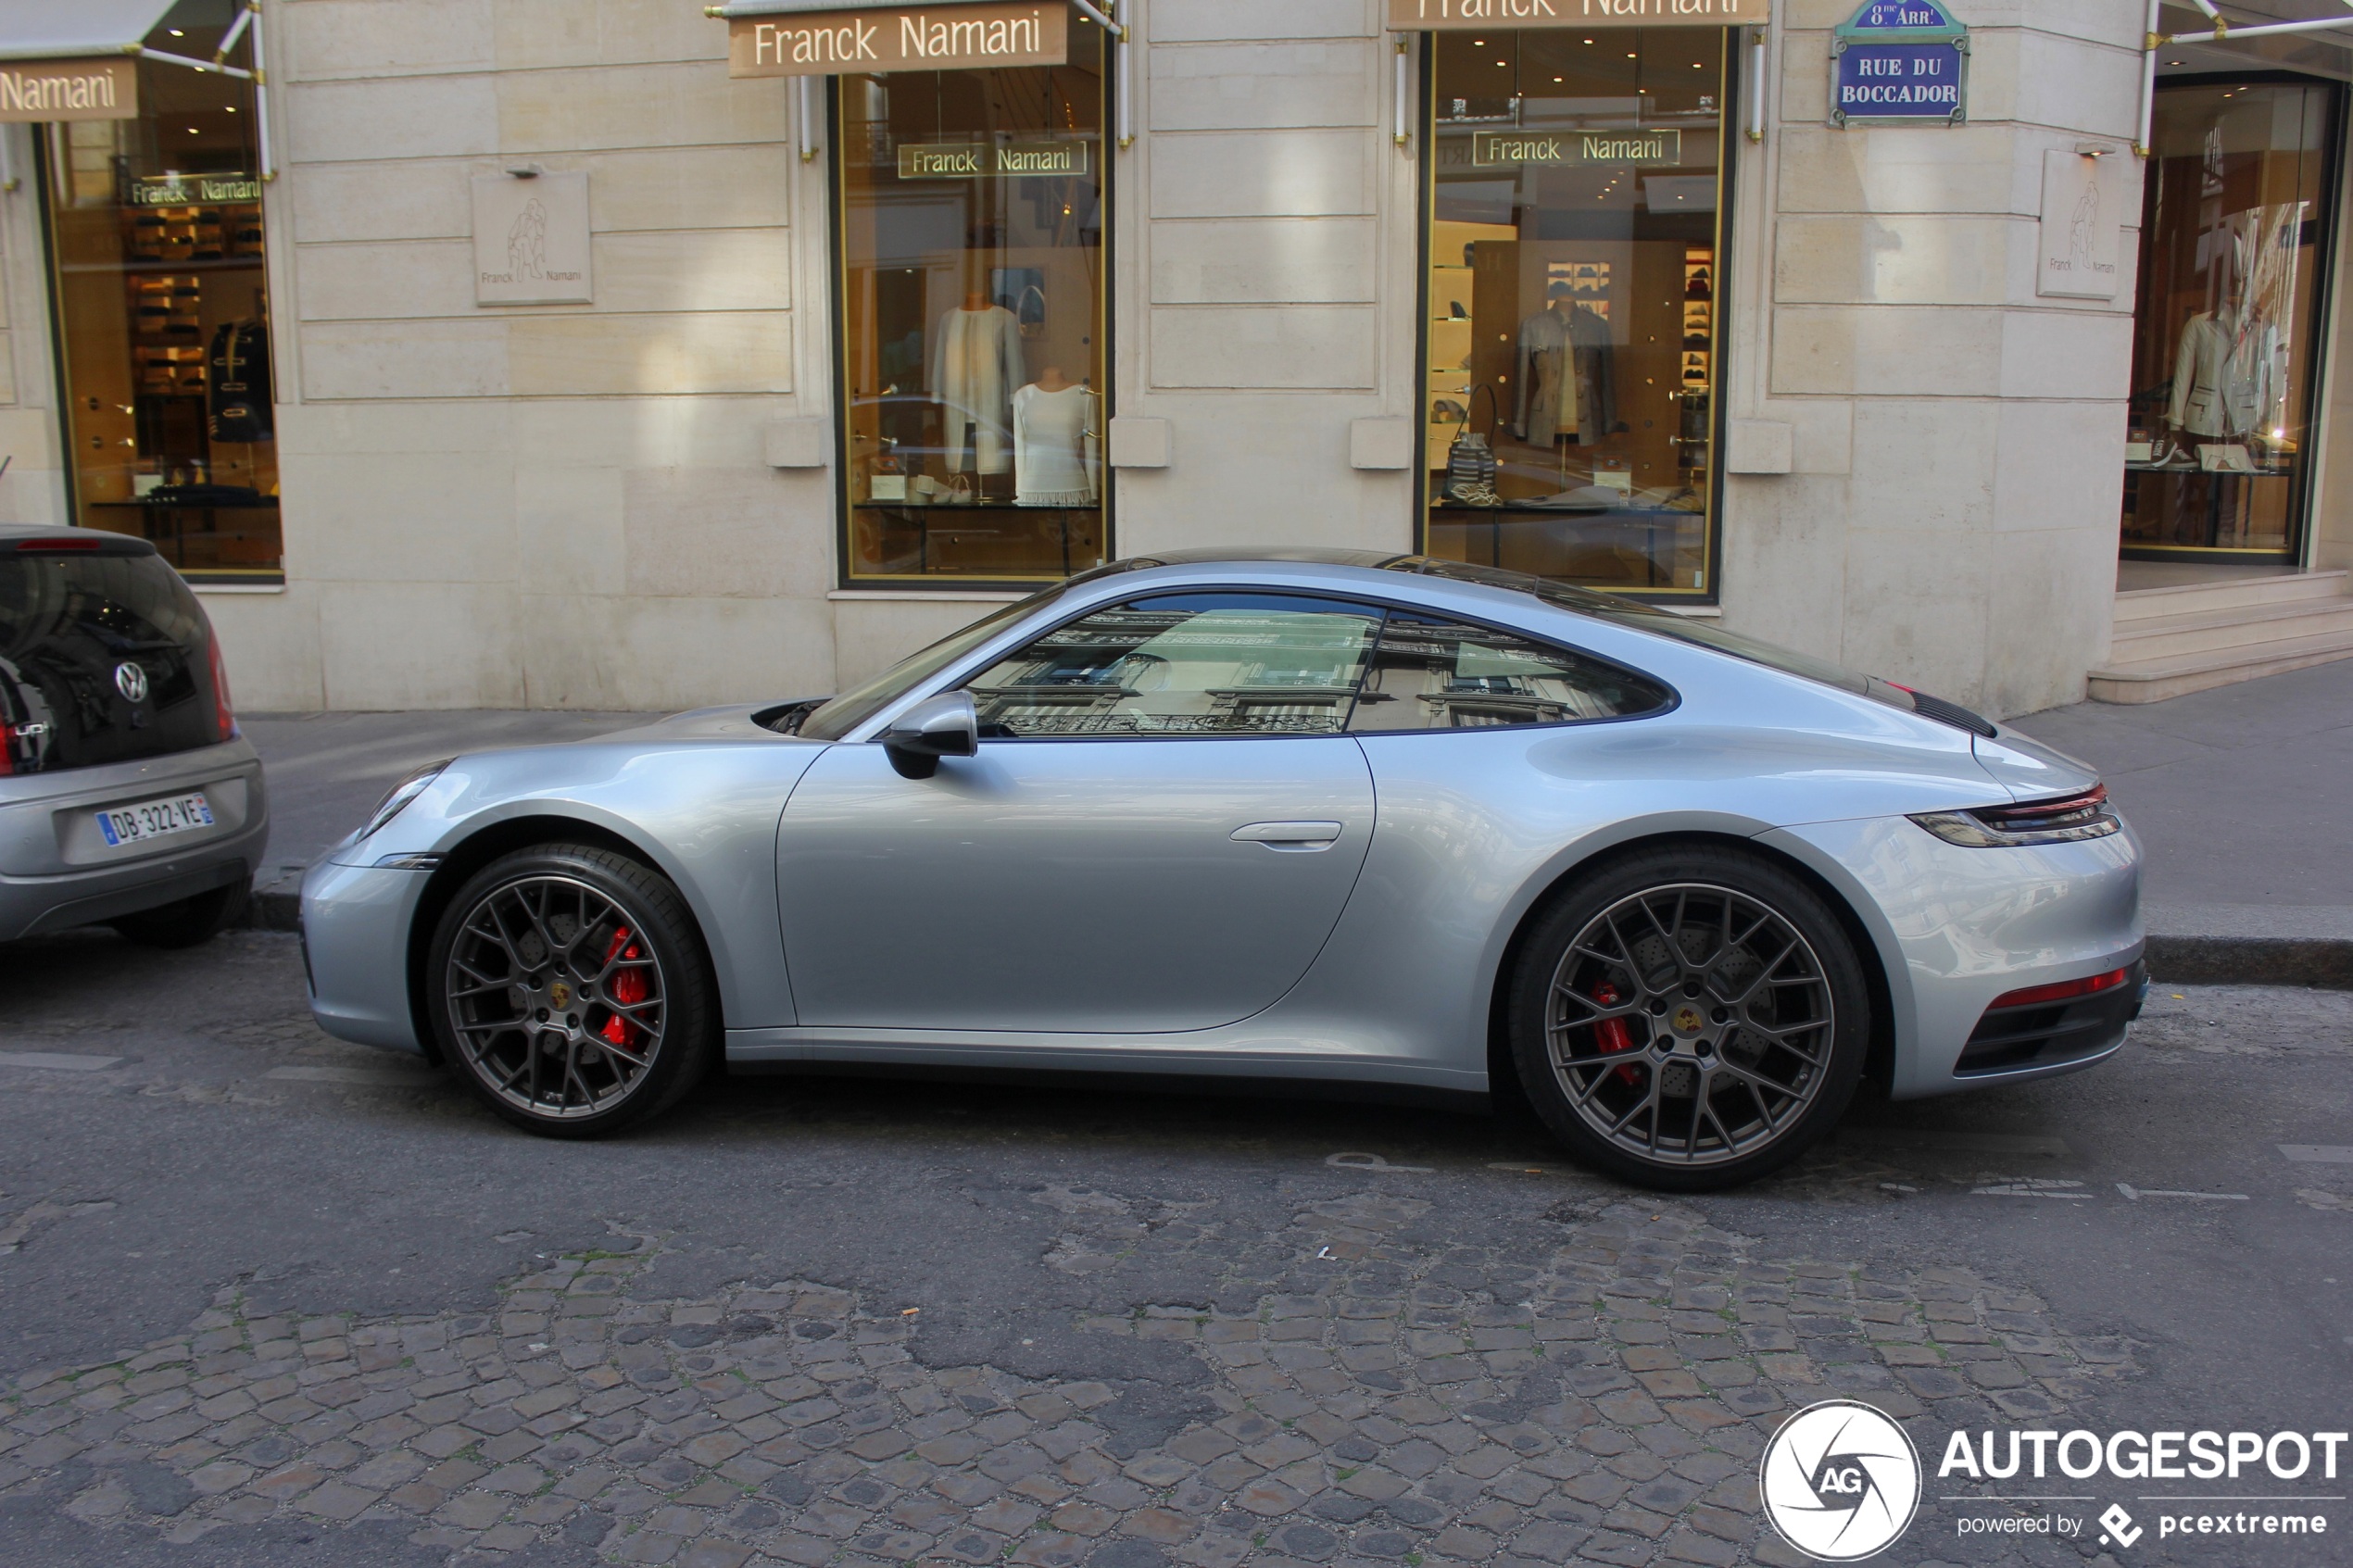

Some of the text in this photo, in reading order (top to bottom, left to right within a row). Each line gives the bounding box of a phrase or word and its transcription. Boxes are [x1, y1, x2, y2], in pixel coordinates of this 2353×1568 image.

[754, 10, 1040, 65] Franck Namani
[1858, 58, 1942, 76] RUE DU
[0, 68, 115, 110] Namani
[1841, 85, 1957, 103] BOCCADOR
[1490, 135, 1662, 160] Franck Namani
[913, 146, 1070, 172] Franck Namani
[132, 183, 188, 204] Franck
[2049, 257, 2116, 274] Franck Namani
[482, 270, 581, 283] Franck Namani
